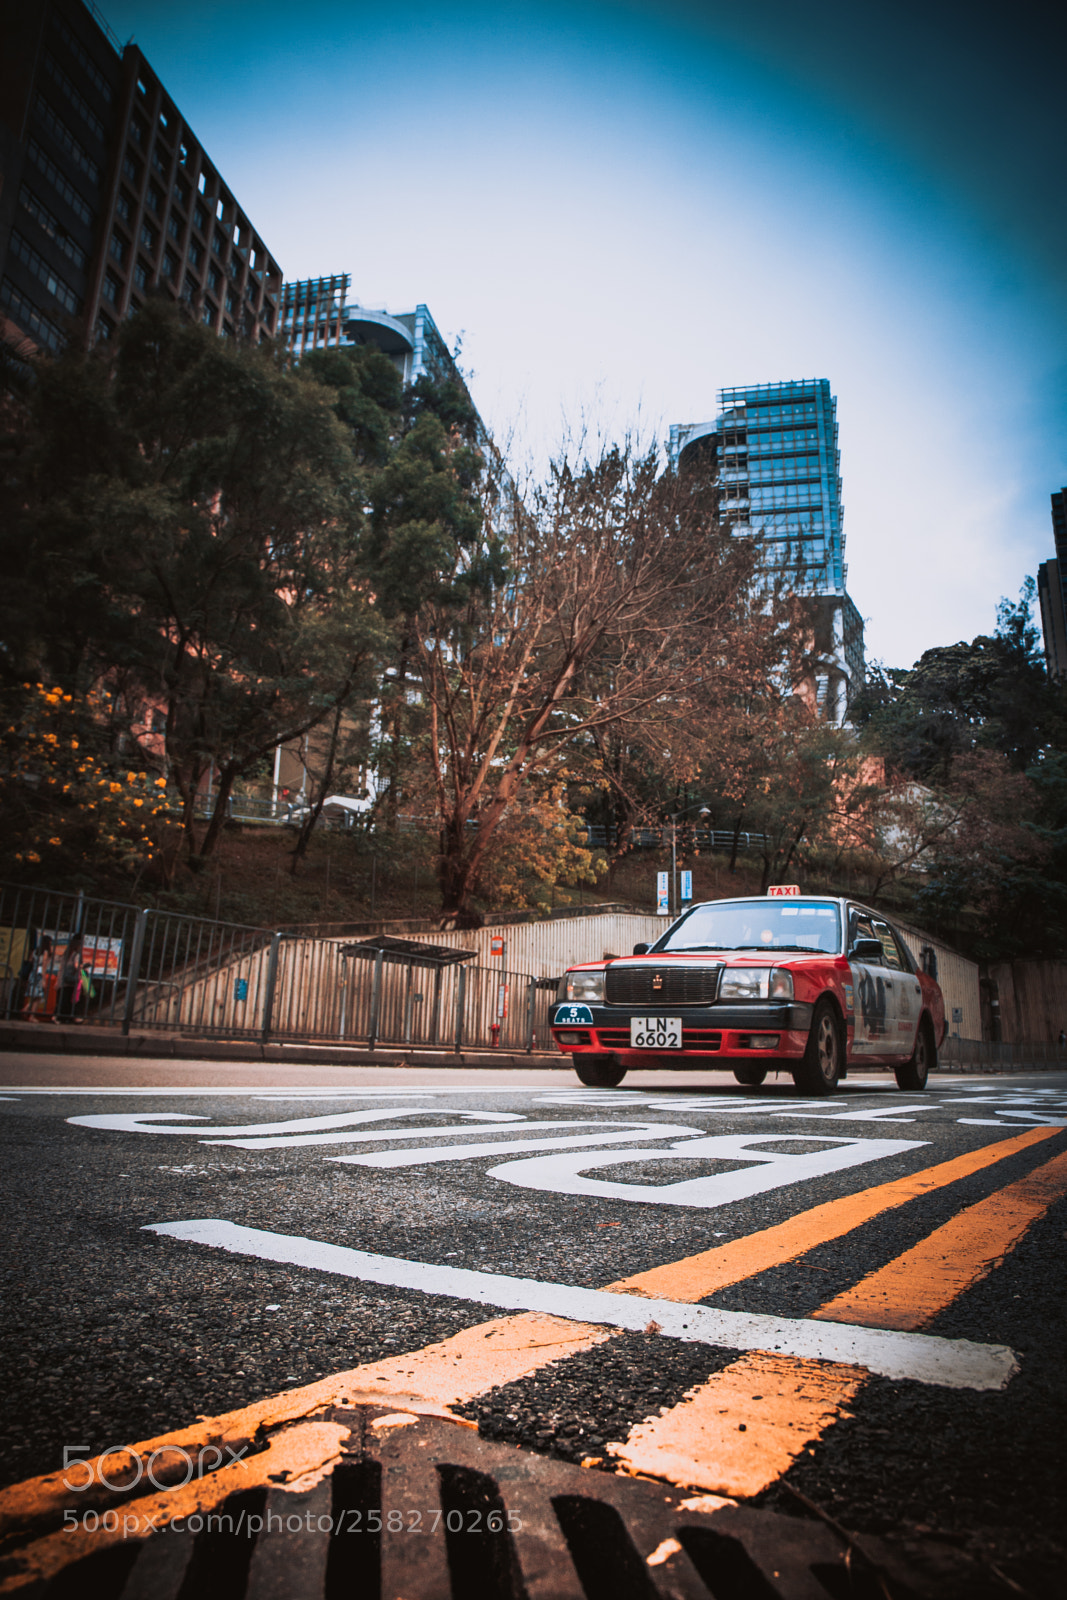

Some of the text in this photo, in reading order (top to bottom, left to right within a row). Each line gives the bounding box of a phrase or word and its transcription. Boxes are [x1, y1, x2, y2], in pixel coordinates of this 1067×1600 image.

[769, 886, 797, 896] TAXI
[569, 1008, 578, 1017] 5
[645, 1018, 667, 1032] LN
[635, 1032, 678, 1047] 6602
[66, 1107, 930, 1208] BUS
